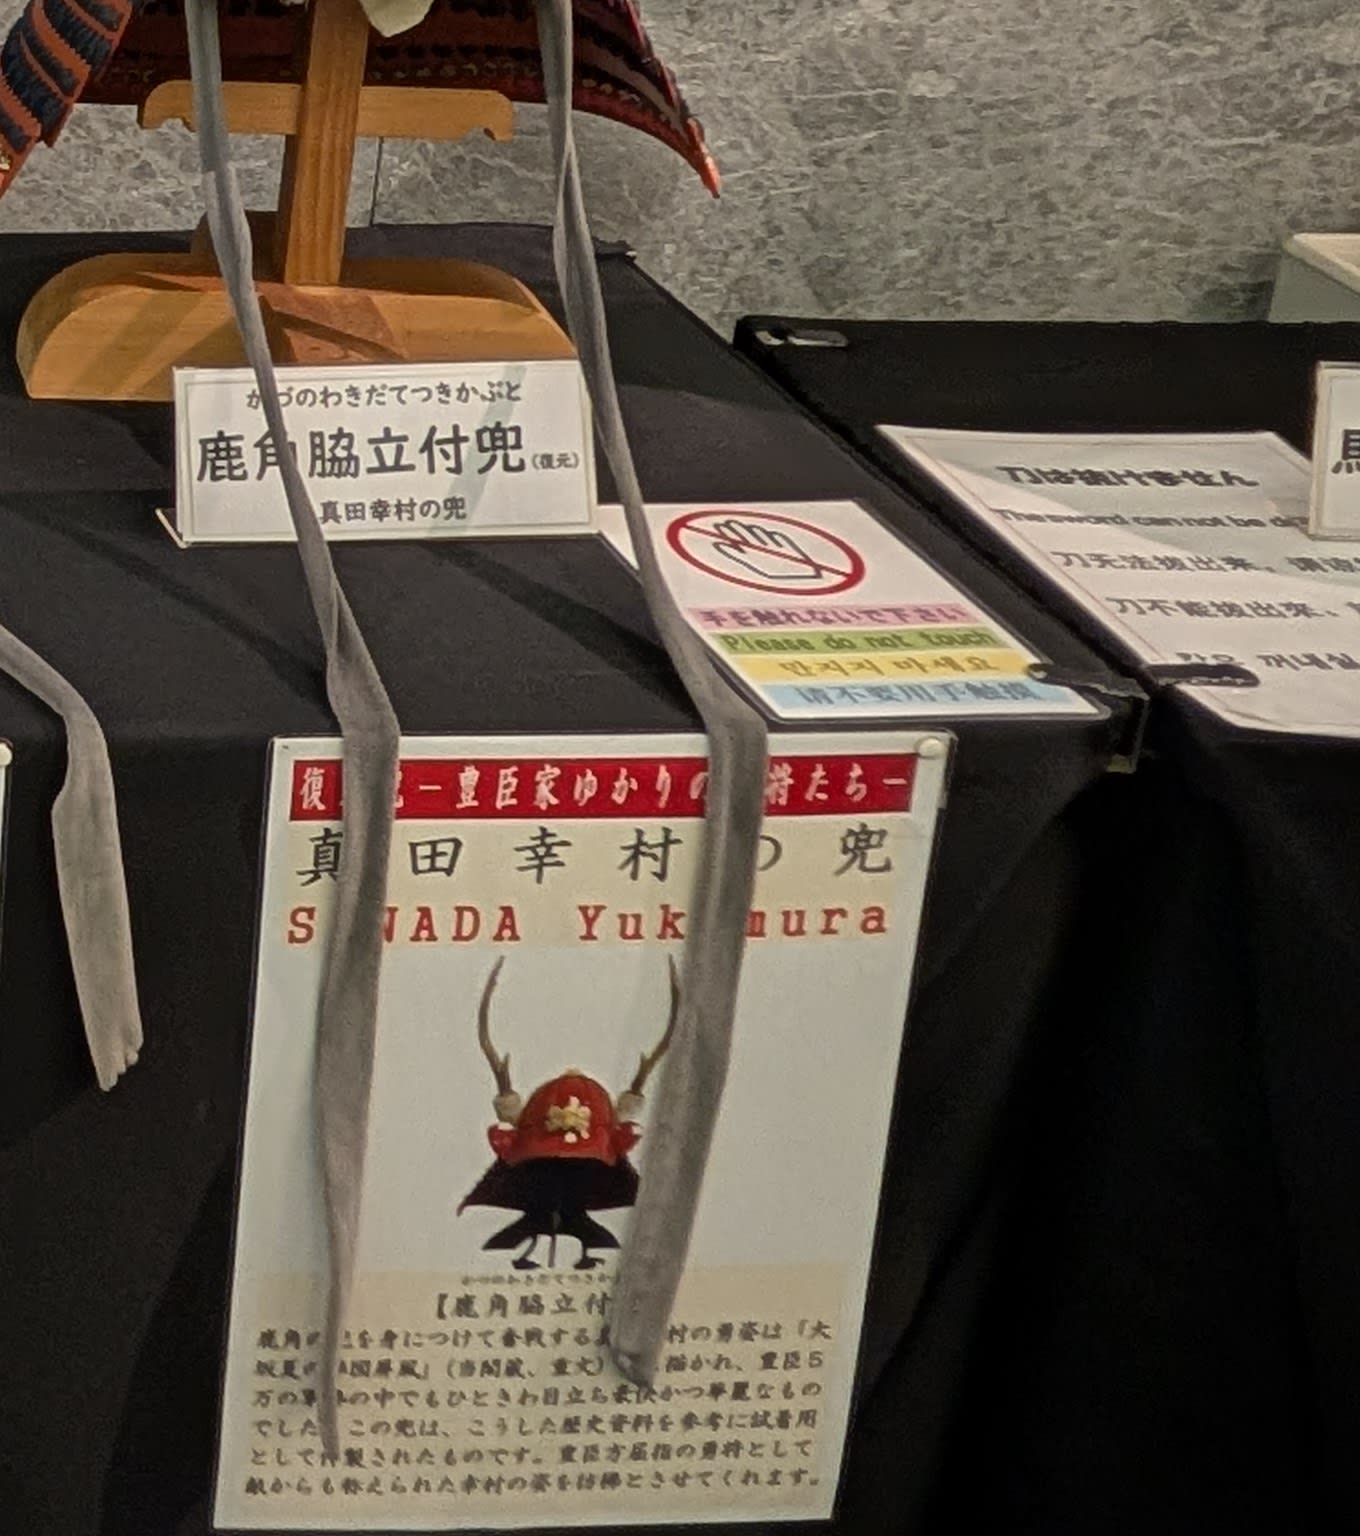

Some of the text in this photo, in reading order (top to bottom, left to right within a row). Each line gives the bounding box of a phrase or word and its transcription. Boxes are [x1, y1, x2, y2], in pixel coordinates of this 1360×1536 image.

[995, 466, 1260, 486] 刀は抜けません
[319, 496, 468, 525] 真田幸村の兜
[702, 604, 971, 629] 手を触れないで下さい
[719, 629, 998, 653] Please do not touch
[287, 904, 887, 946] SNADA Yukmura
[436, 1292, 611, 1320] 【鹿角脇立付
